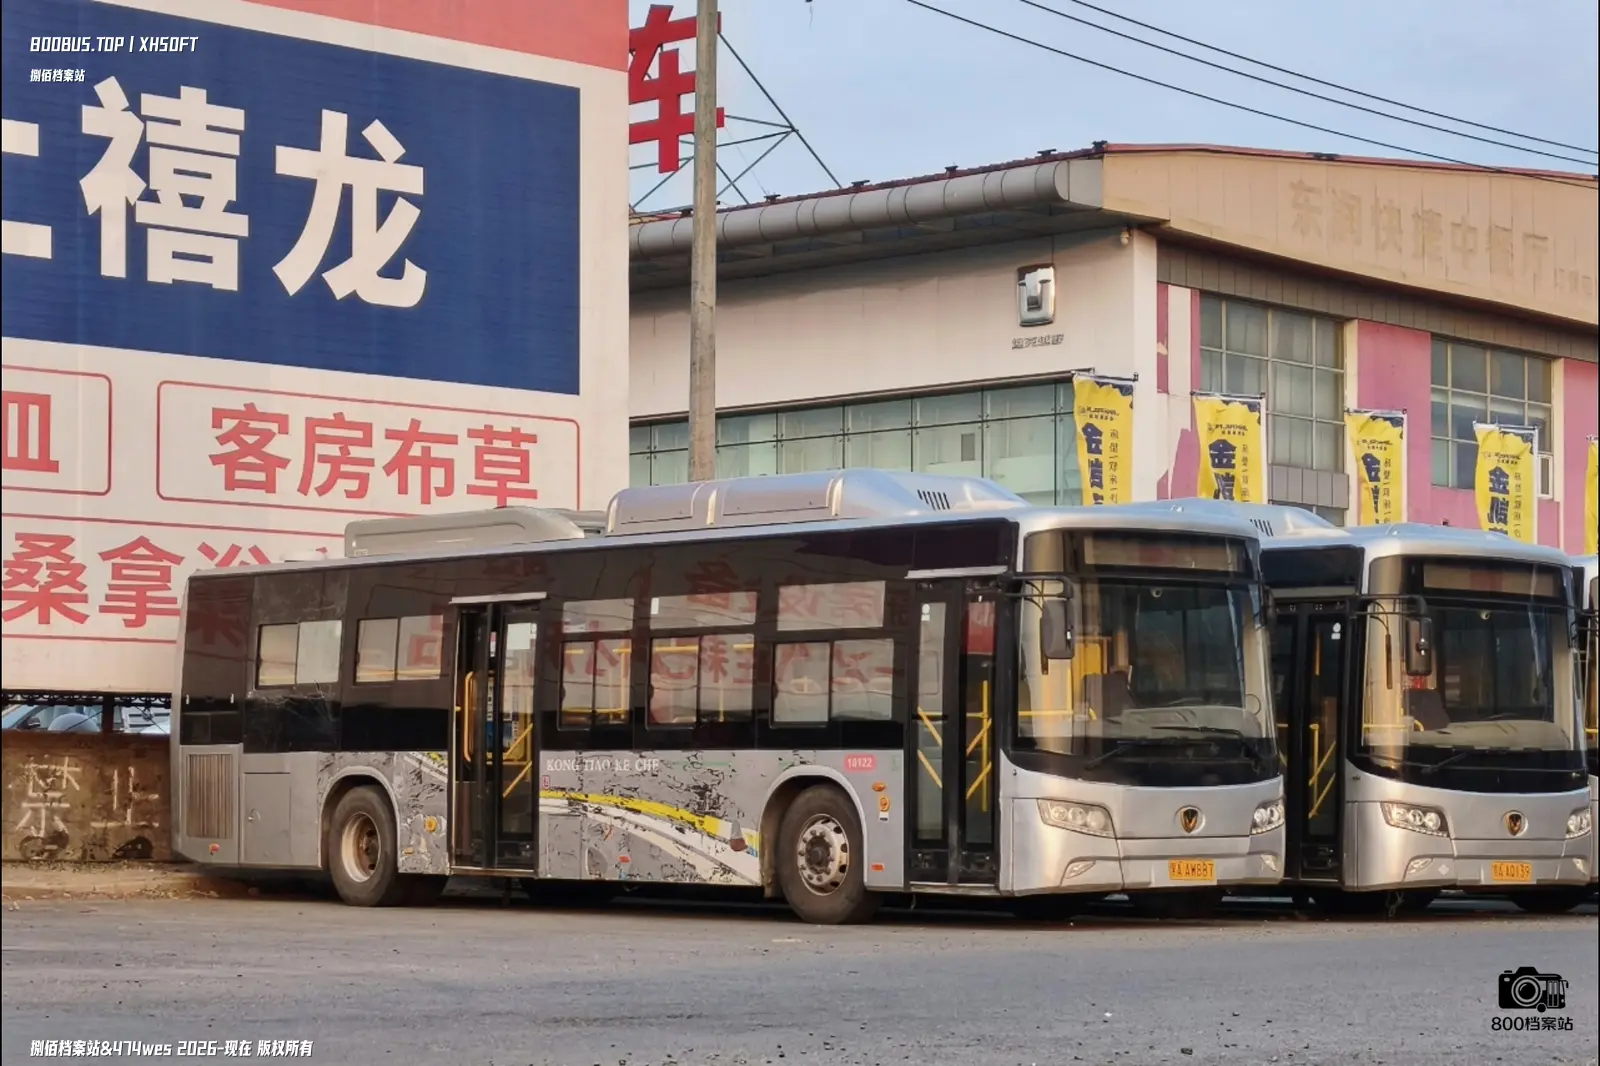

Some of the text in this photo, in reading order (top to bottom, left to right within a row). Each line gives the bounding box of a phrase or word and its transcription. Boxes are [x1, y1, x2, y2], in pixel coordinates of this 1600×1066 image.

[2, 76, 427, 308] 禧龙
[208, 402, 539, 507] 客房布草
[14, 755, 161, 838] 禁止
[546, 758, 660, 772] KONG TIAO KE CHE
